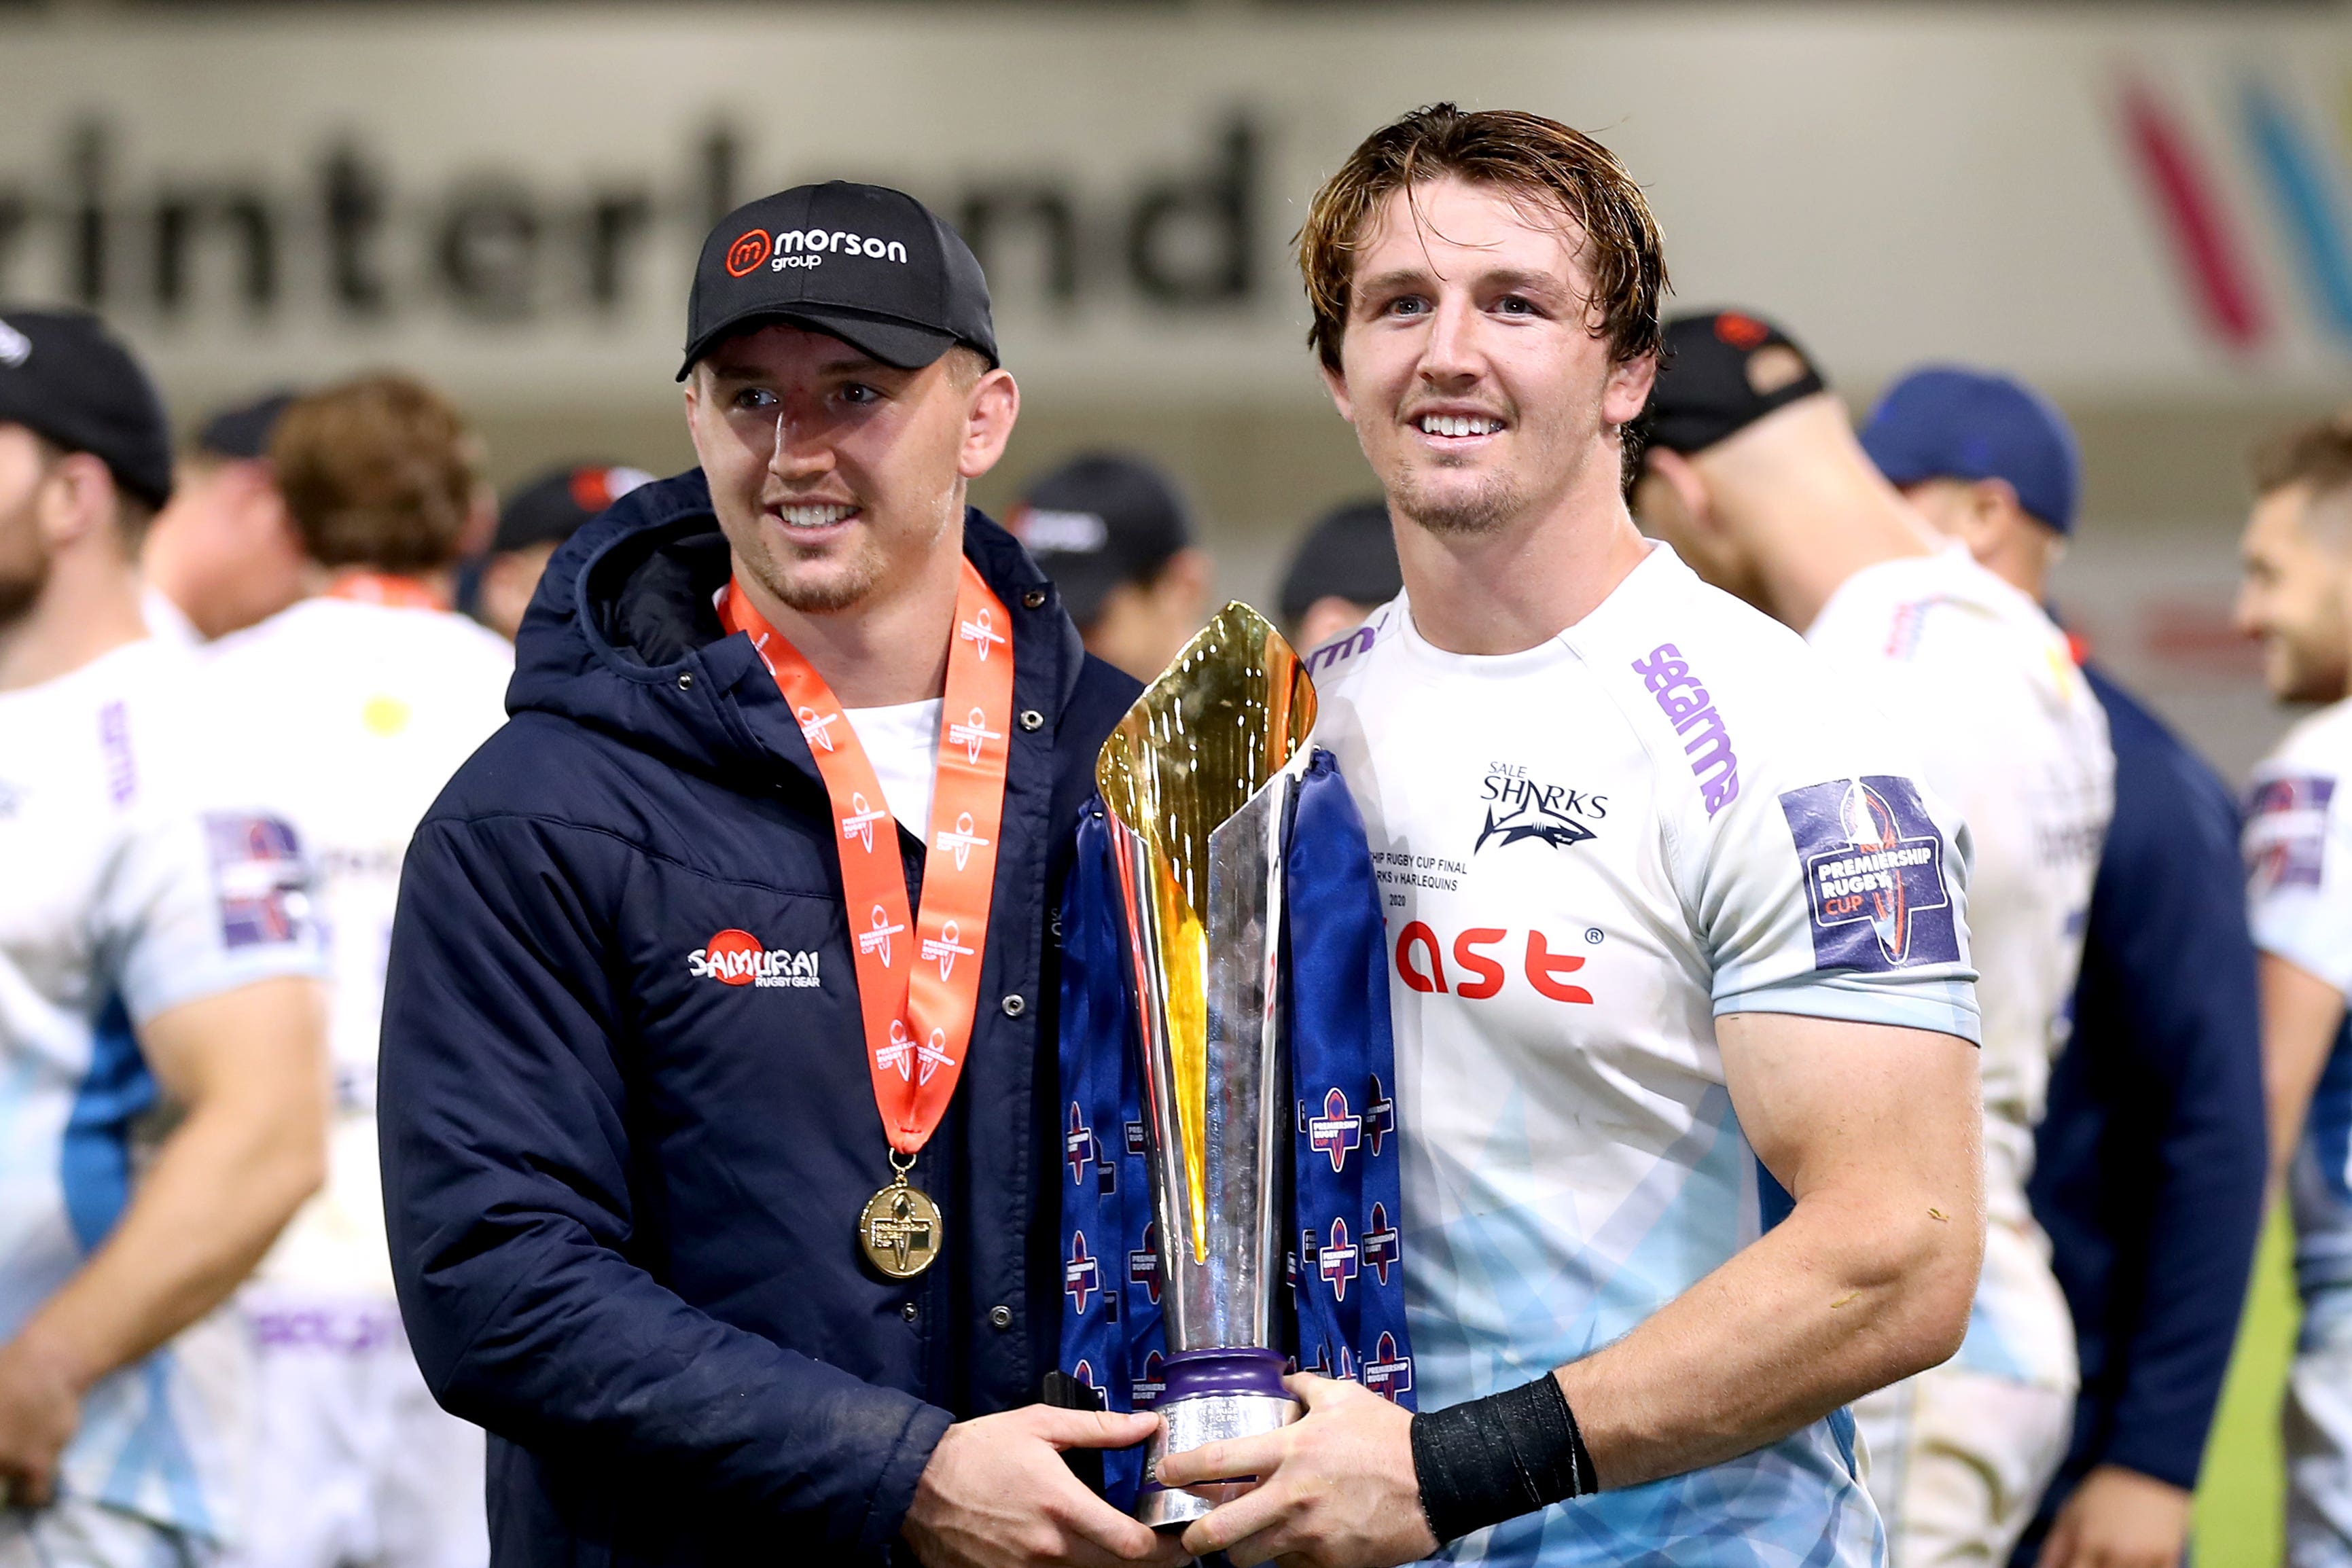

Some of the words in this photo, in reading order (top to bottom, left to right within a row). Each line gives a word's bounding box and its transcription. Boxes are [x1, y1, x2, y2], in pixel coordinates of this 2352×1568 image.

[774, 229, 907, 264] morson
[771, 255, 822, 272] group
[1631, 643, 1739, 823] secarma
[1489, 762, 1527, 779] SALE
[1480, 775, 1608, 819] SHARKS
[1387, 853, 1414, 868] RUGBY
[1416, 856, 1436, 870] CUP
[1438, 859, 1467, 875] FINAL
[1818, 847, 1932, 881] PREMIERSHIP
[1376, 870, 1392, 883] RKS
[1400, 873, 1458, 891] HARLEQUINS
[1821, 870, 1890, 899] RUGBY
[1389, 893, 1406, 907] 2020
[1824, 895, 1864, 915] CUP
[688, 949, 818, 979] SAMURAI
[1386, 919, 1594, 1005] ast
[755, 976, 790, 988] RUGBY
[791, 976, 820, 988] GEAR
